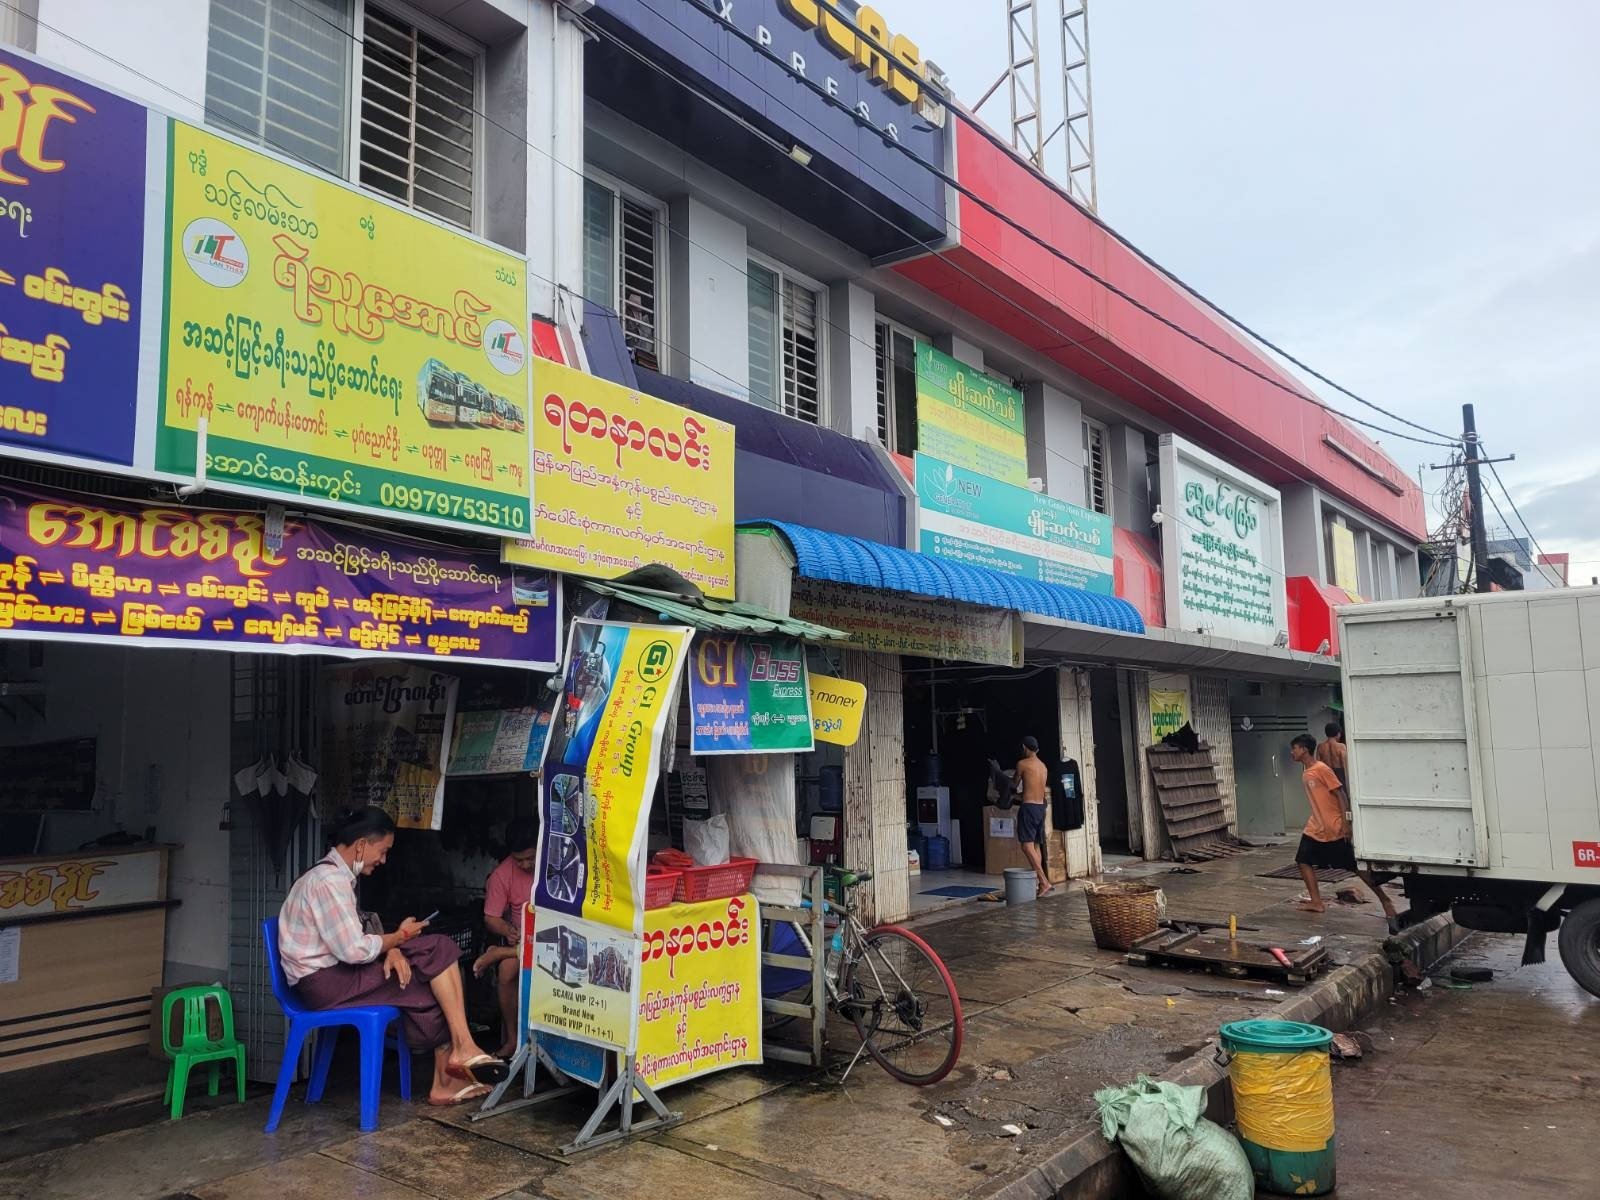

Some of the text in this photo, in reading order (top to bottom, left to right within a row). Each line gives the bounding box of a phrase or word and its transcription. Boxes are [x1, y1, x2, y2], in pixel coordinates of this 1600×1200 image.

[544, 393, 711, 471] ရတနာလင်း
[958, 479, 983, 498] NEW
[380, 482, 524, 529] 09979753510
[699, 636, 739, 688] GI
[817, 691, 858, 708] money
[620, 719, 643, 778] Group
[575, 993, 587, 1004] VIP
[588, 996, 608, 1011] (2+1)
[543, 1012, 567, 1027] YUTONG
[568, 1019, 583, 1031] VVIP
[562, 1004, 595, 1022] Brand New
